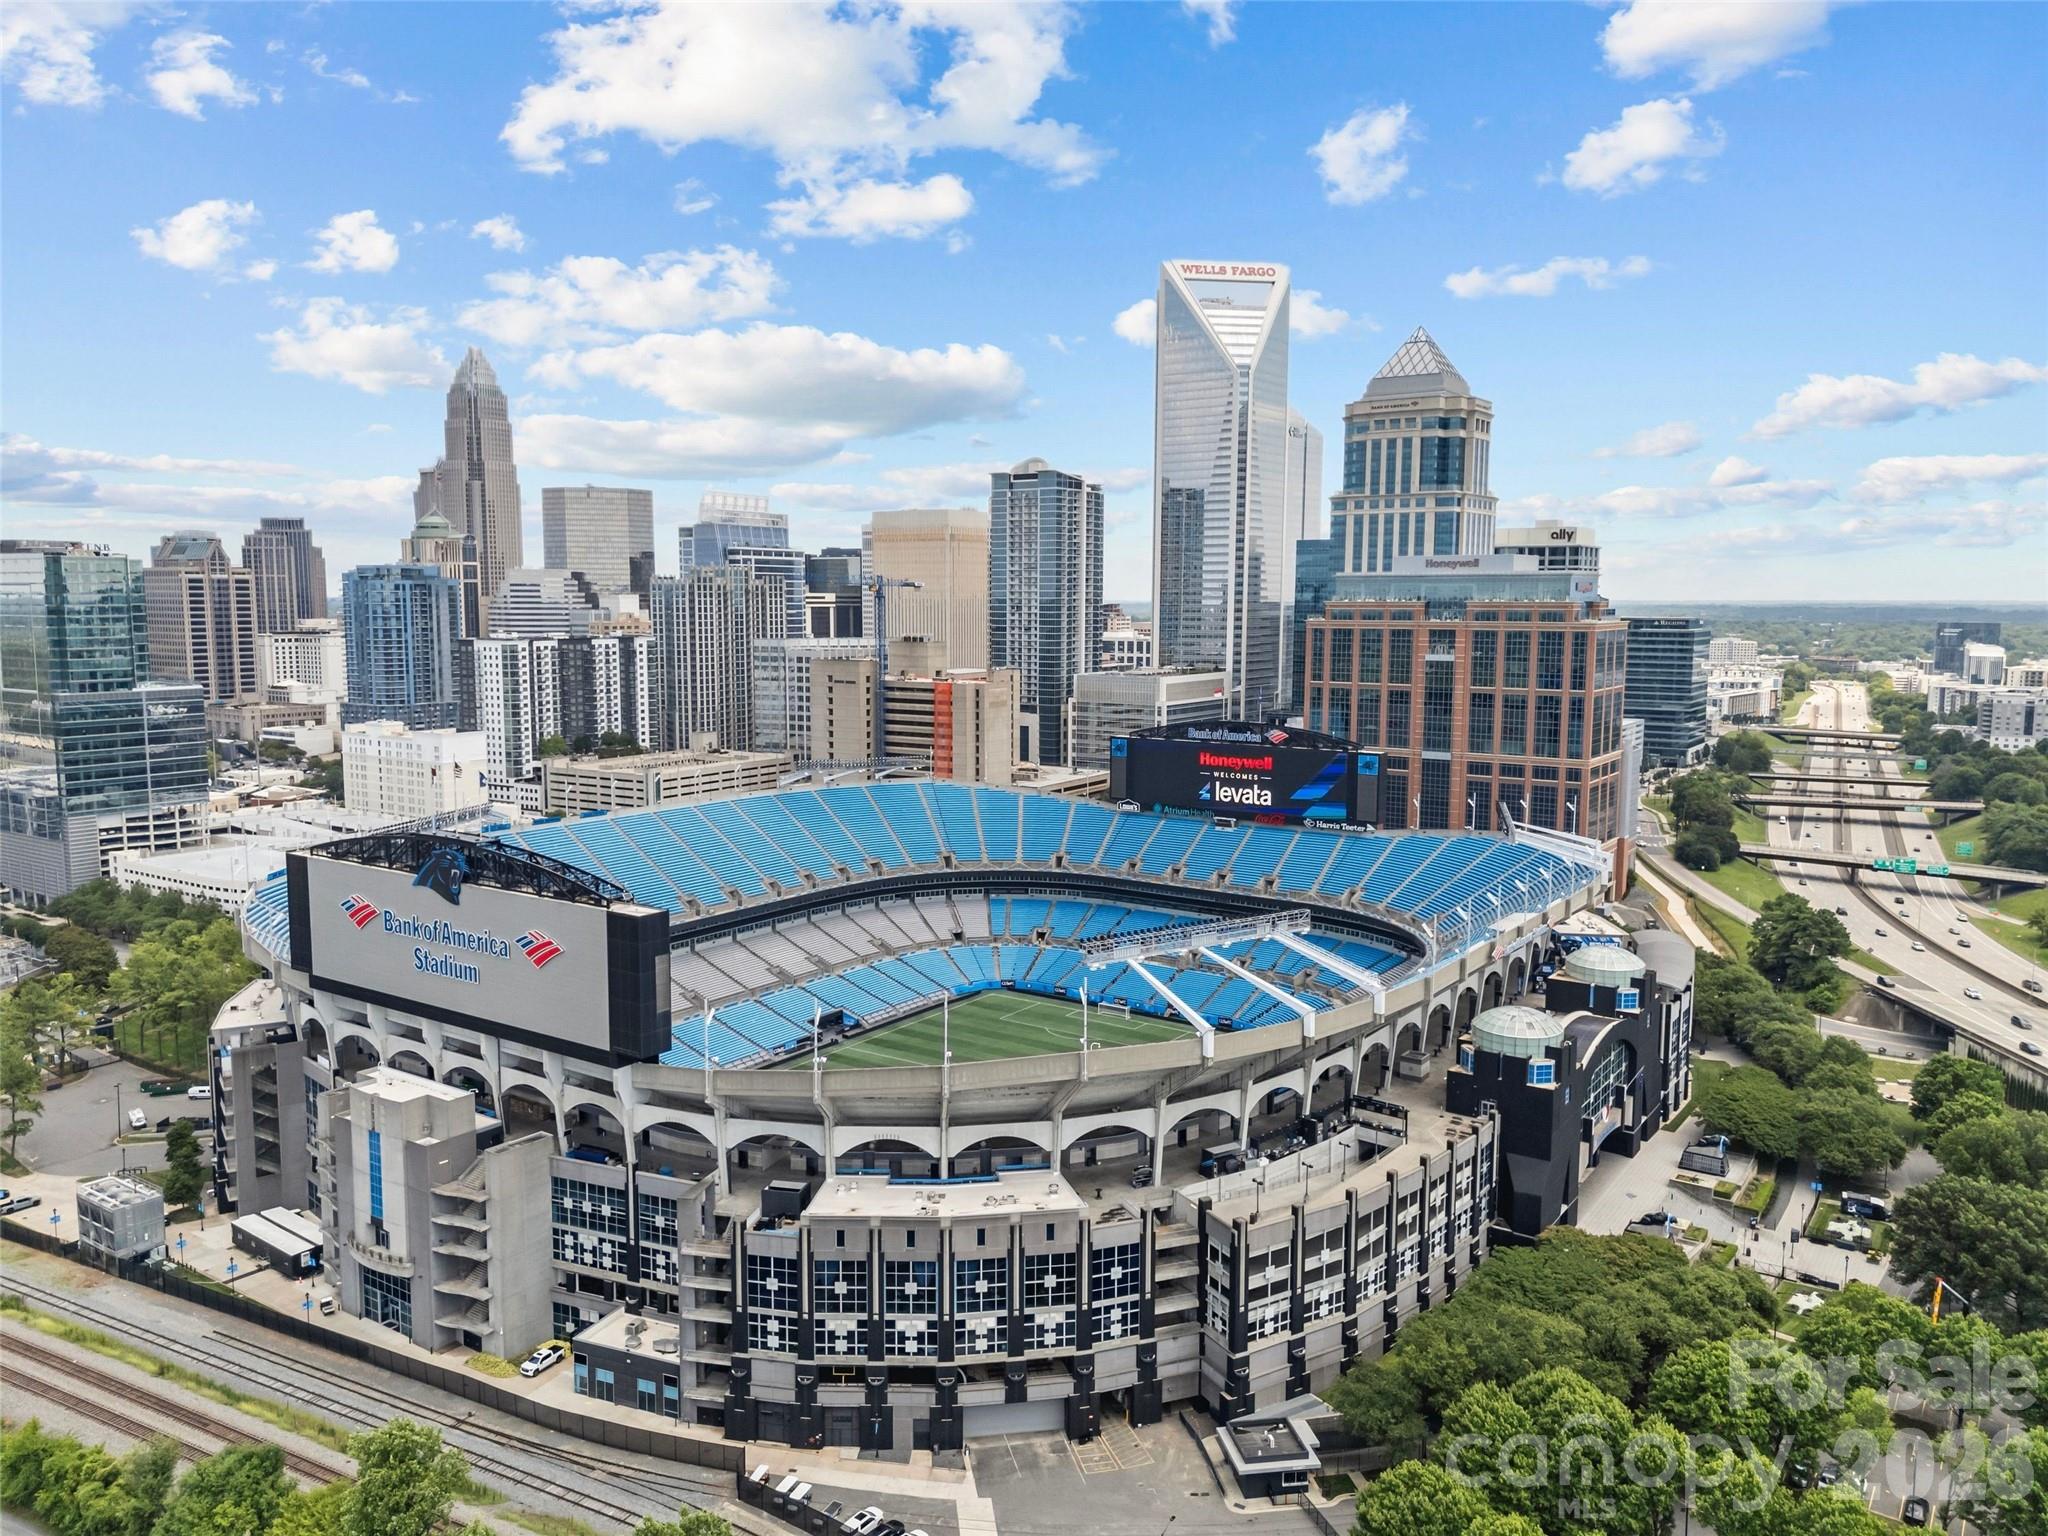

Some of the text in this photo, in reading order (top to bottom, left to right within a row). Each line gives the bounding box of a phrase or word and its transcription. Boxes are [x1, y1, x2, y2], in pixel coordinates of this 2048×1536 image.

[1180, 264, 1277, 278] WELLS FARGO
[1550, 528, 1575, 543] ally
[1424, 558, 1480, 571] Honeywell
[1187, 726, 1263, 743] Bank of America
[1199, 751, 1274, 771] Honeywell
[1213, 771, 1259, 781] WELCOMES
[1215, 780, 1273, 807] levata
[1163, 805, 1190, 817] Atrium
[1316, 820, 1366, 832] Harris Teeter
[383, 908, 511, 959] Bank of America
[413, 946, 481, 985] Stadium
